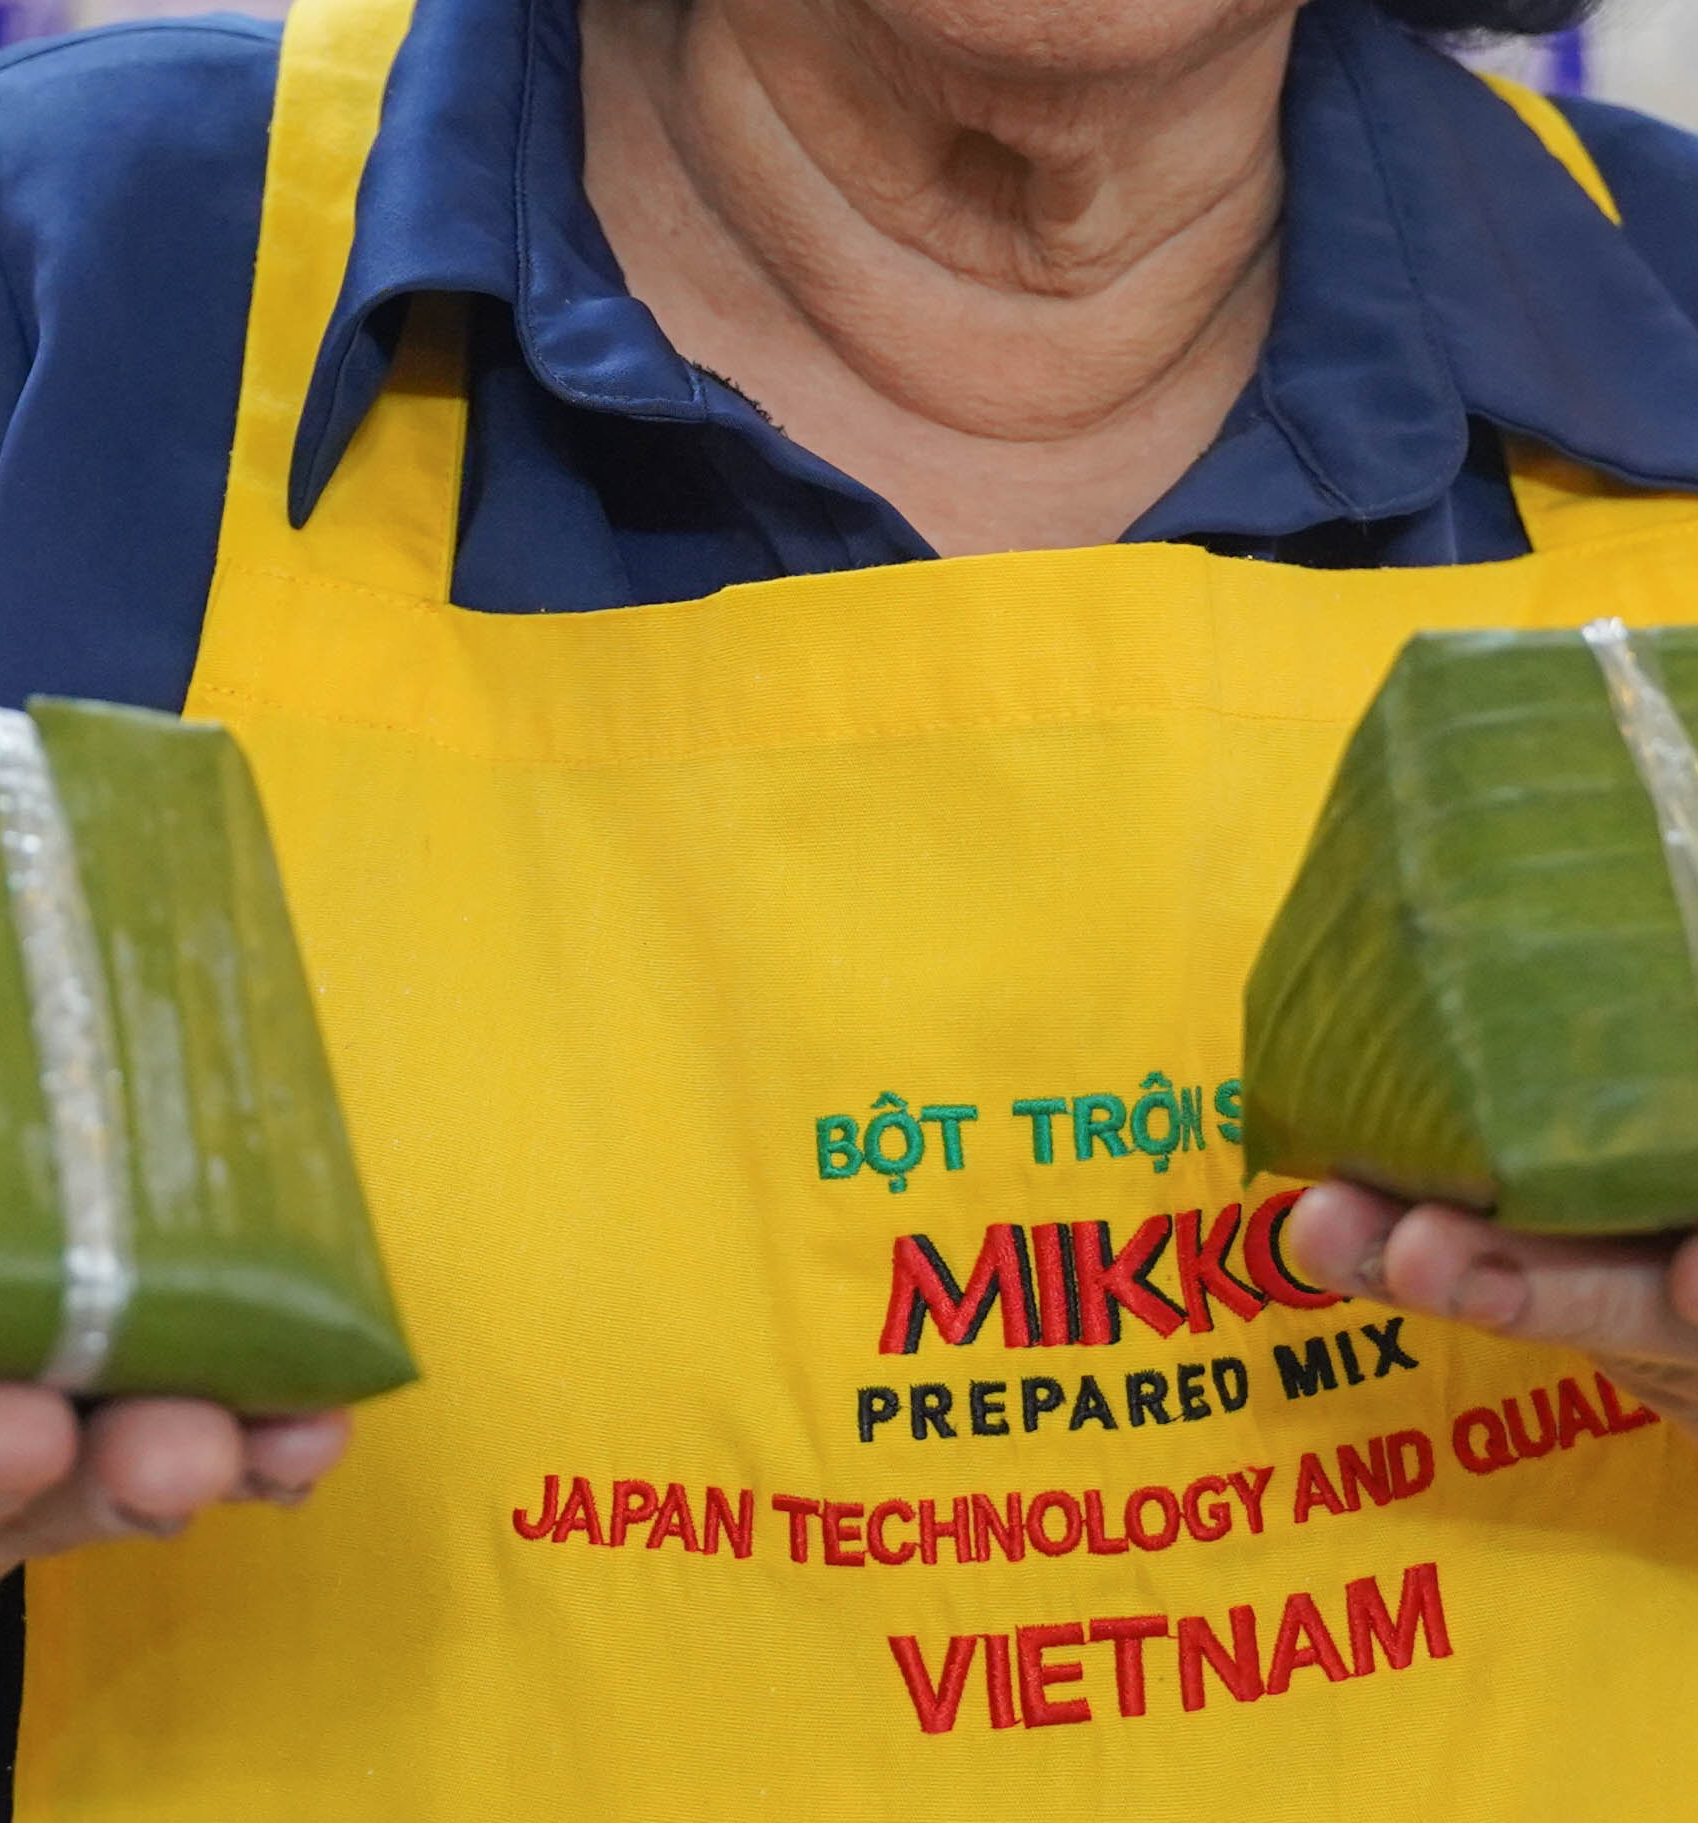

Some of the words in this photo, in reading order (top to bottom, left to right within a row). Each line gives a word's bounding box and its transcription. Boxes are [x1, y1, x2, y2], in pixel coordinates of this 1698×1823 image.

[815, 1091, 979, 1194] BỘT
[1011, 1070, 1207, 1174] TRỘN
[856, 1356, 1249, 1444] PREPARED
[1272, 1316, 1420, 1400] MIX
[512, 1474, 755, 1560] JAPAN
[771, 1466, 1276, 1568] TECHNOLOGY
[1293, 1428, 1436, 1524] AND
[1451, 1370, 1661, 1478] QUAL
[887, 1562, 1454, 1735] VIETNAM
